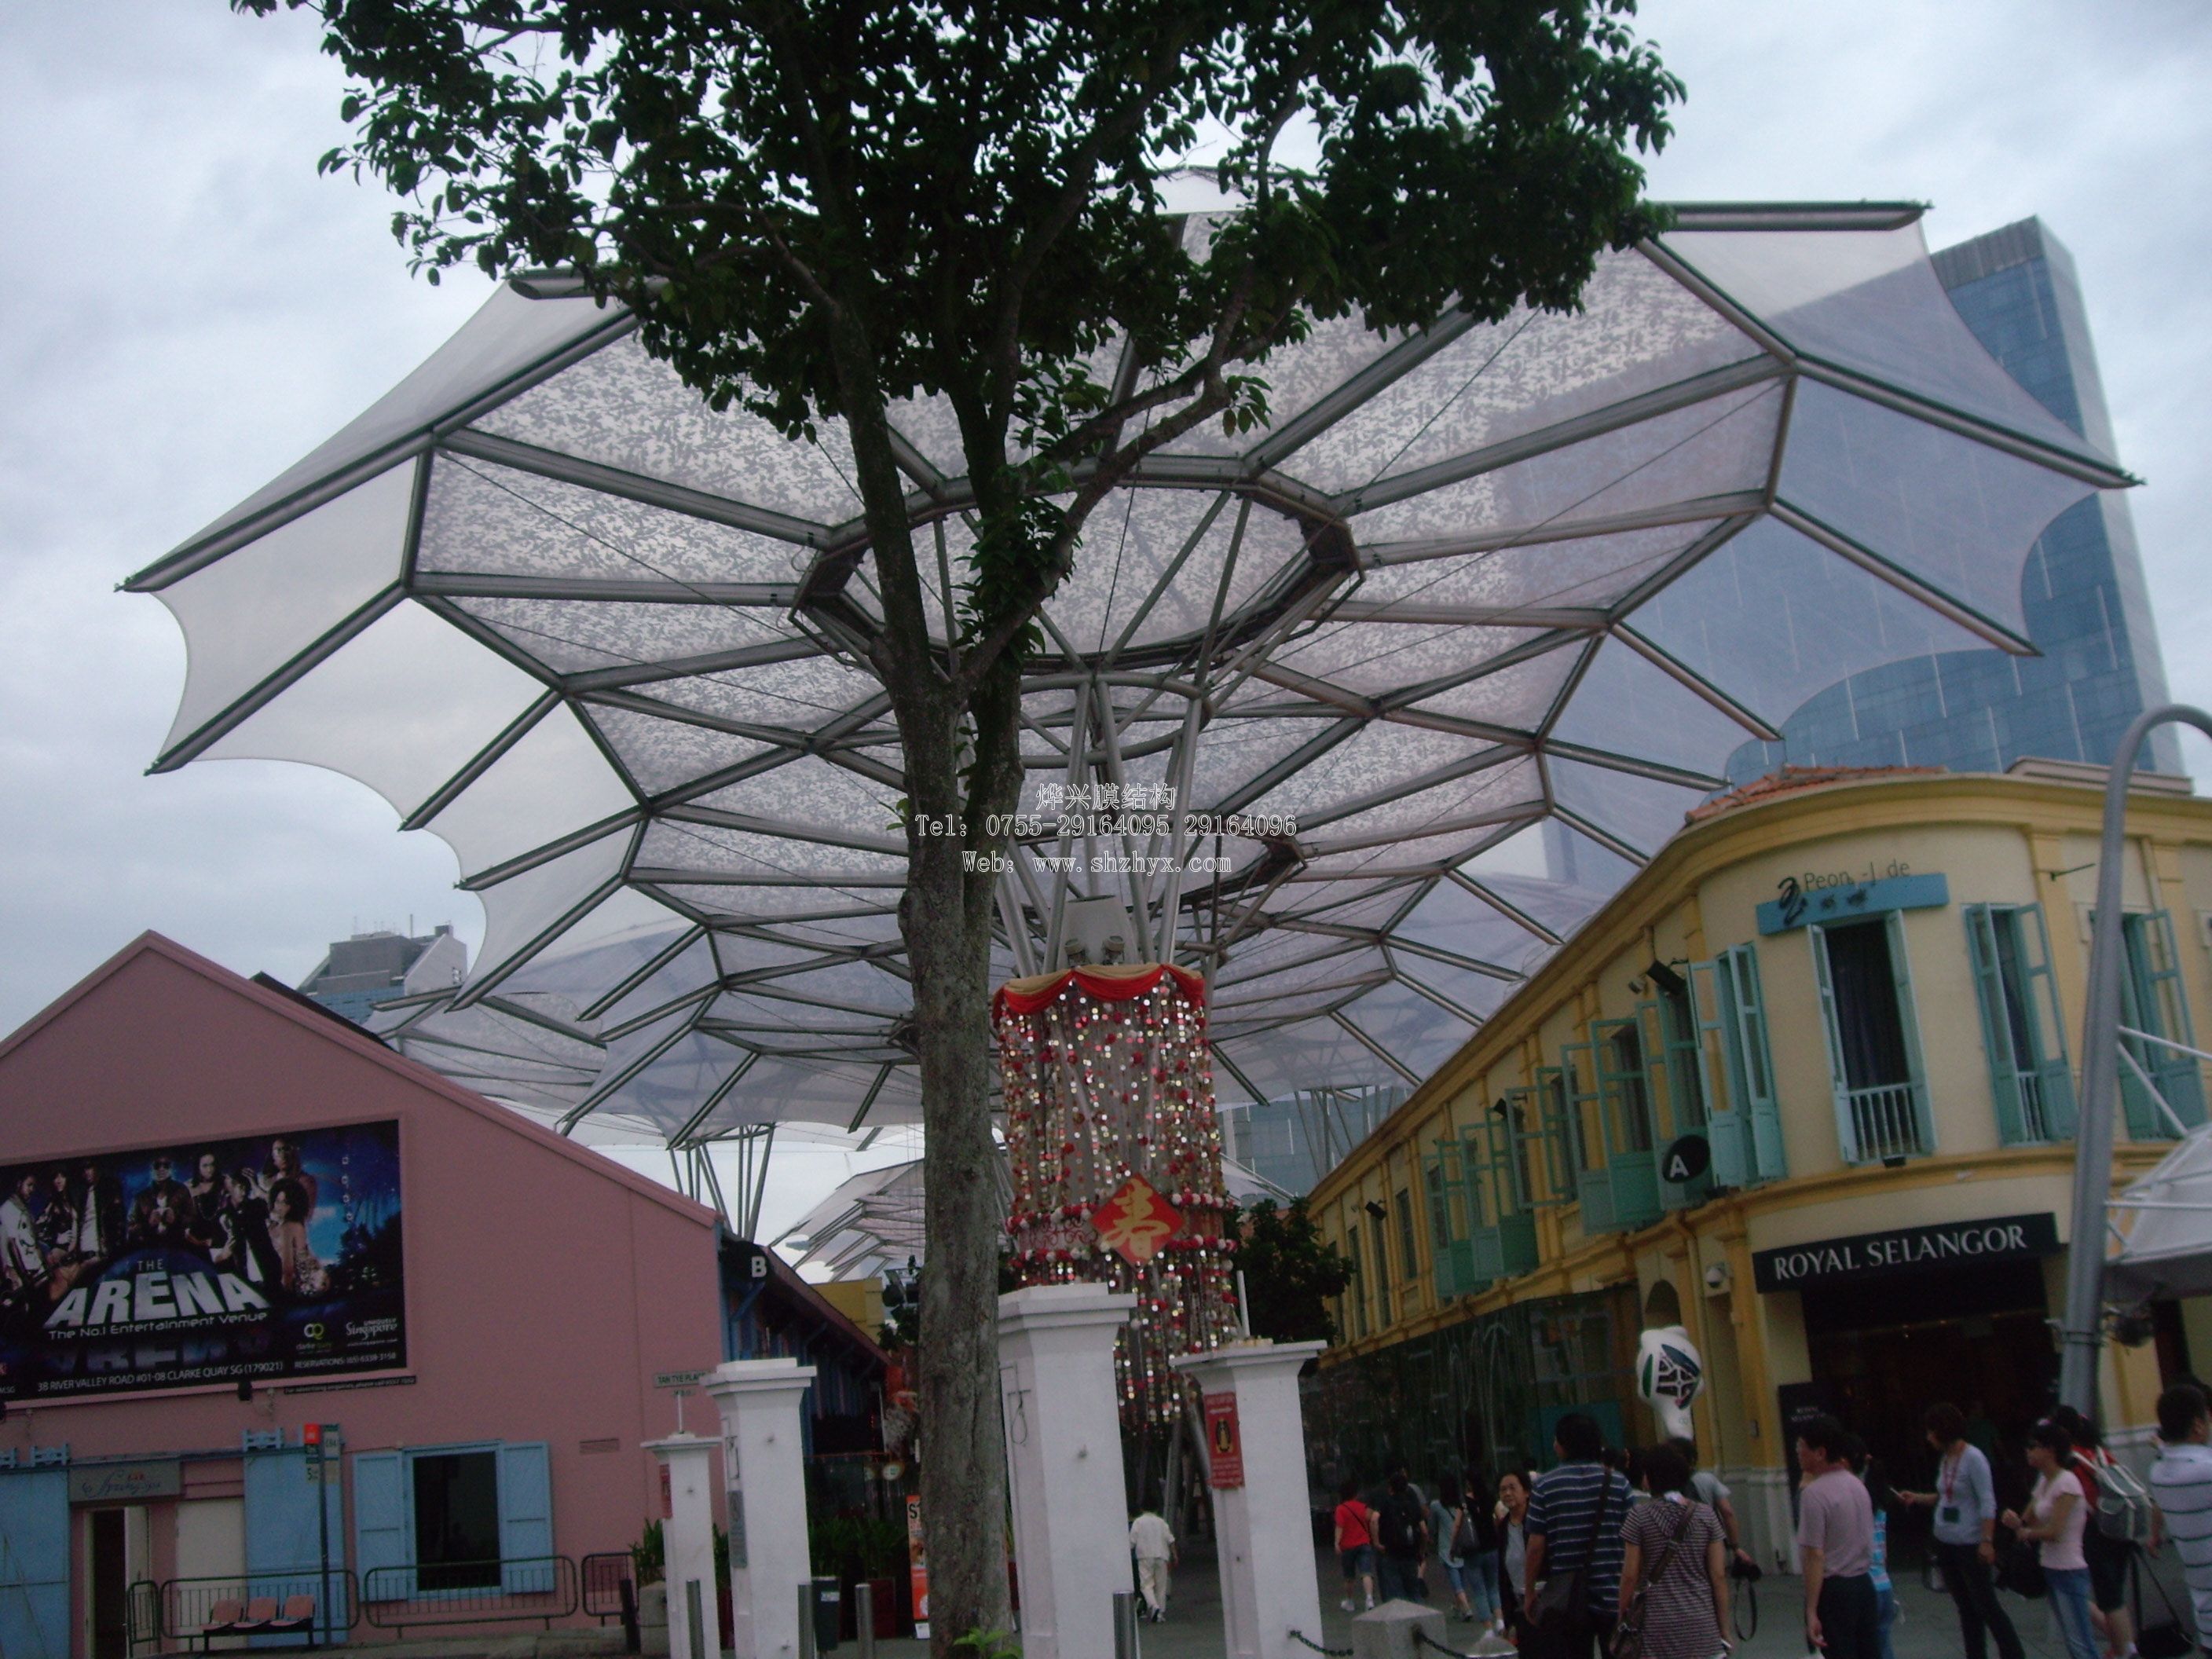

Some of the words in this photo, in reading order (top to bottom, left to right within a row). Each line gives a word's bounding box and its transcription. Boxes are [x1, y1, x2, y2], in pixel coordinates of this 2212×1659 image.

[1669, 1154, 1690, 1178] A
[137, 1258, 164, 1271] THE
[751, 1255, 767, 1278] B
[1773, 1246, 1862, 1282] ROYAL
[1866, 1225, 2029, 1268] SELANGOR
[43, 1270, 272, 1329] ARENA
[48, 1329, 76, 1340] The
[111, 1316, 215, 1335] Entertainment
[219, 1312, 268, 1324] Venue
[49, 1379, 75, 1390] RIVER
[75, 1376, 108, 1388] VALLEY
[108, 1374, 134, 1385] ROAD
[167, 1368, 201, 1380] CLARKE
[203, 1365, 229, 1378] QUAY
[230, 1364, 244, 1375] SG
